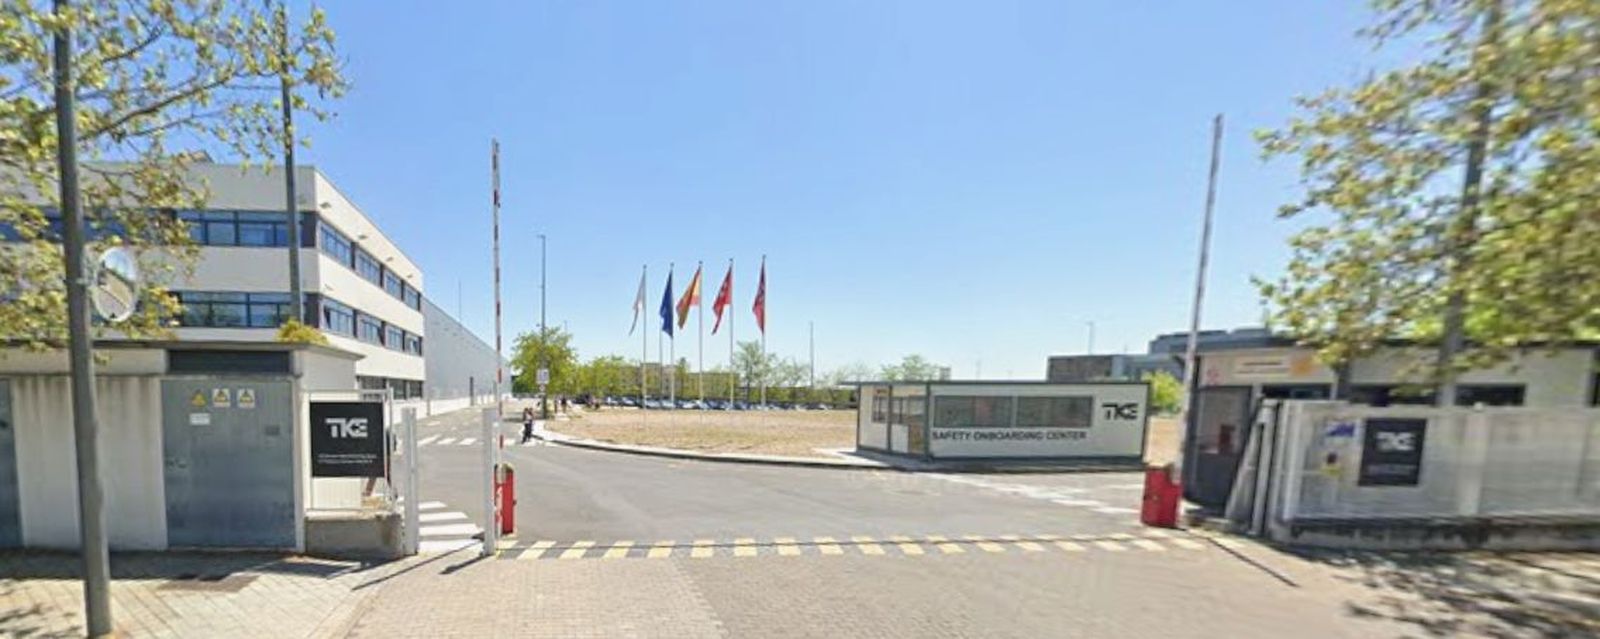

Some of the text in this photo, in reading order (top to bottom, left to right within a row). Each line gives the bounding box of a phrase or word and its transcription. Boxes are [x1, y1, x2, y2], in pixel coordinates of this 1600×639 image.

[1102, 403, 1138, 420] TKE
[325, 418, 368, 438] TKE
[932, 430, 1087, 441] SAFETY ONBOARDING CENTER
